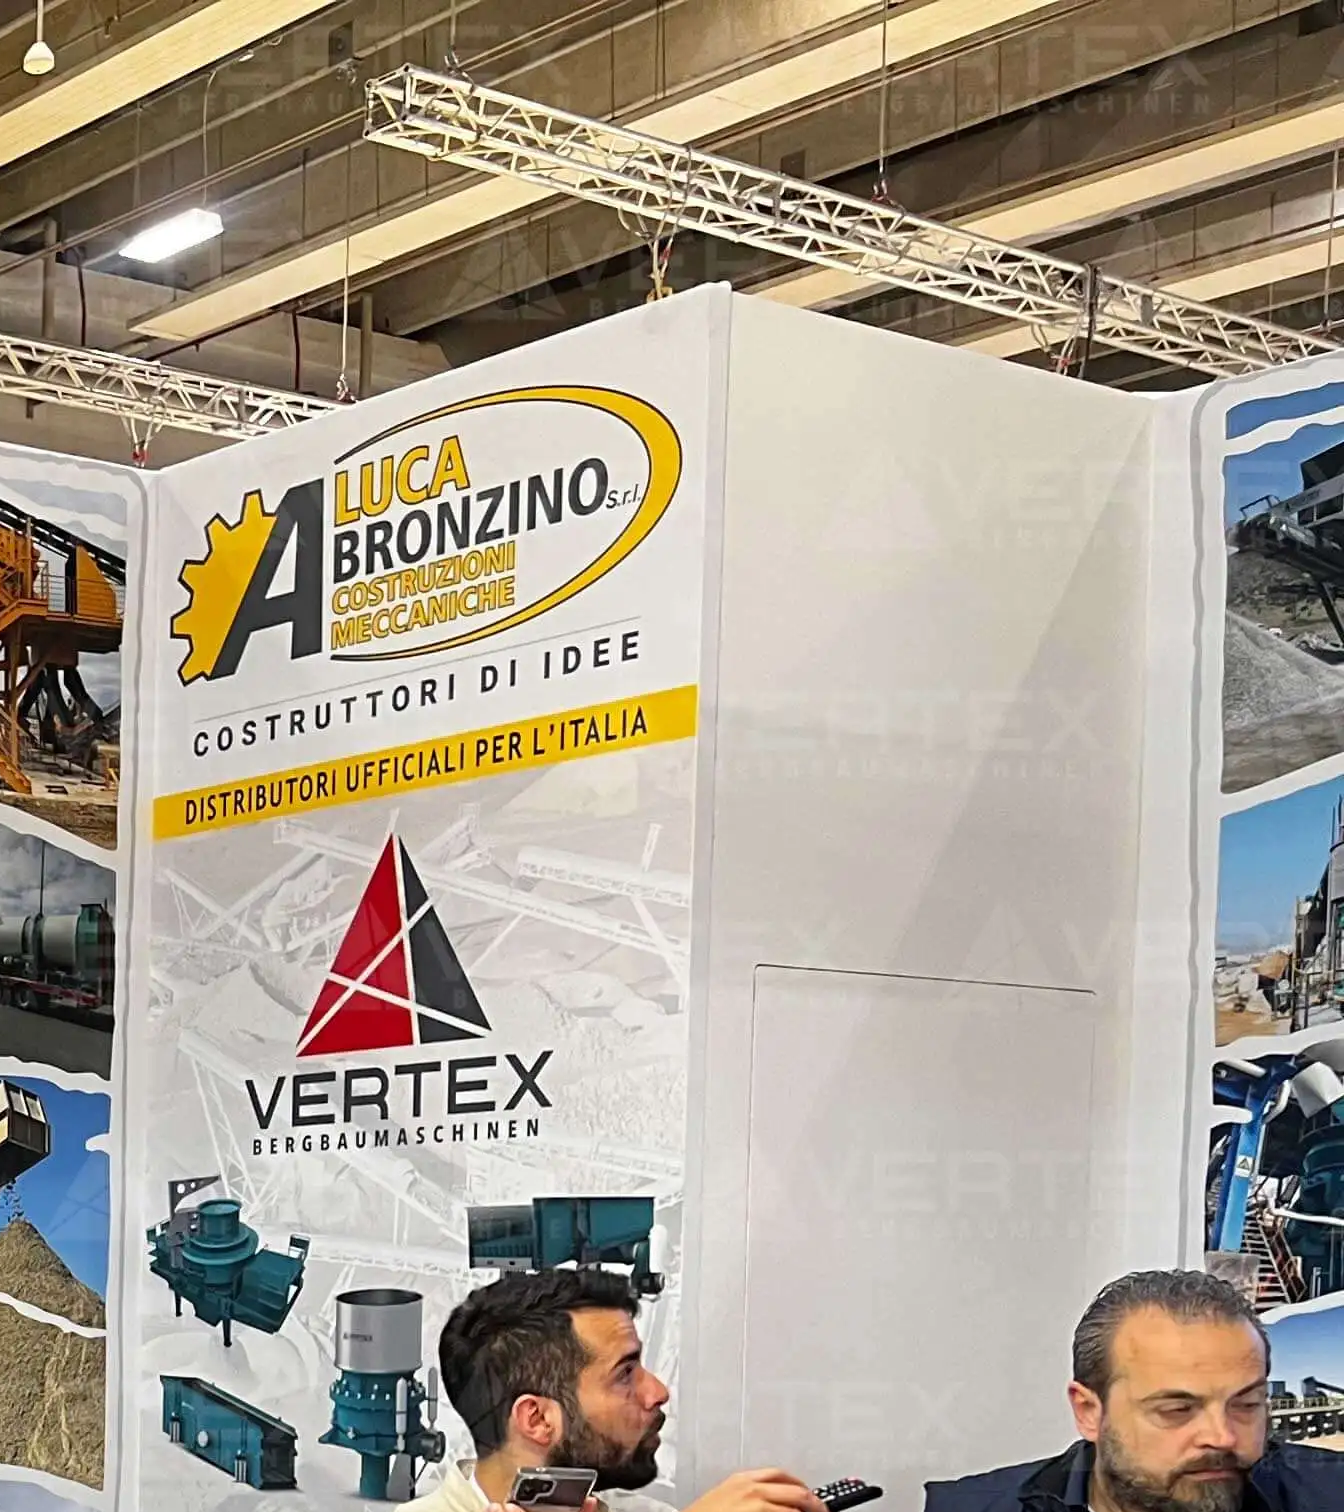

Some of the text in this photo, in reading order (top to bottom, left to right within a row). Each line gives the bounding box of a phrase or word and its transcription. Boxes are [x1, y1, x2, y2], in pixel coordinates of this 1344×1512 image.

[332, 457, 609, 584] BRONZINO
[334, 436, 470, 526] LUCA
[330, 575, 515, 651] MECCANICHE
[331, 541, 516, 615] COSTRUZIONI
[193, 629, 642, 758] COSTRUTTORI DI IDEE
[184, 704, 649, 826] DISTRIBUTORI UFFICIALI PER L'ITALIA
[245, 1049, 555, 1131] VERTEX
[251, 1118, 542, 1156] BERGBAUMASCHINEN
